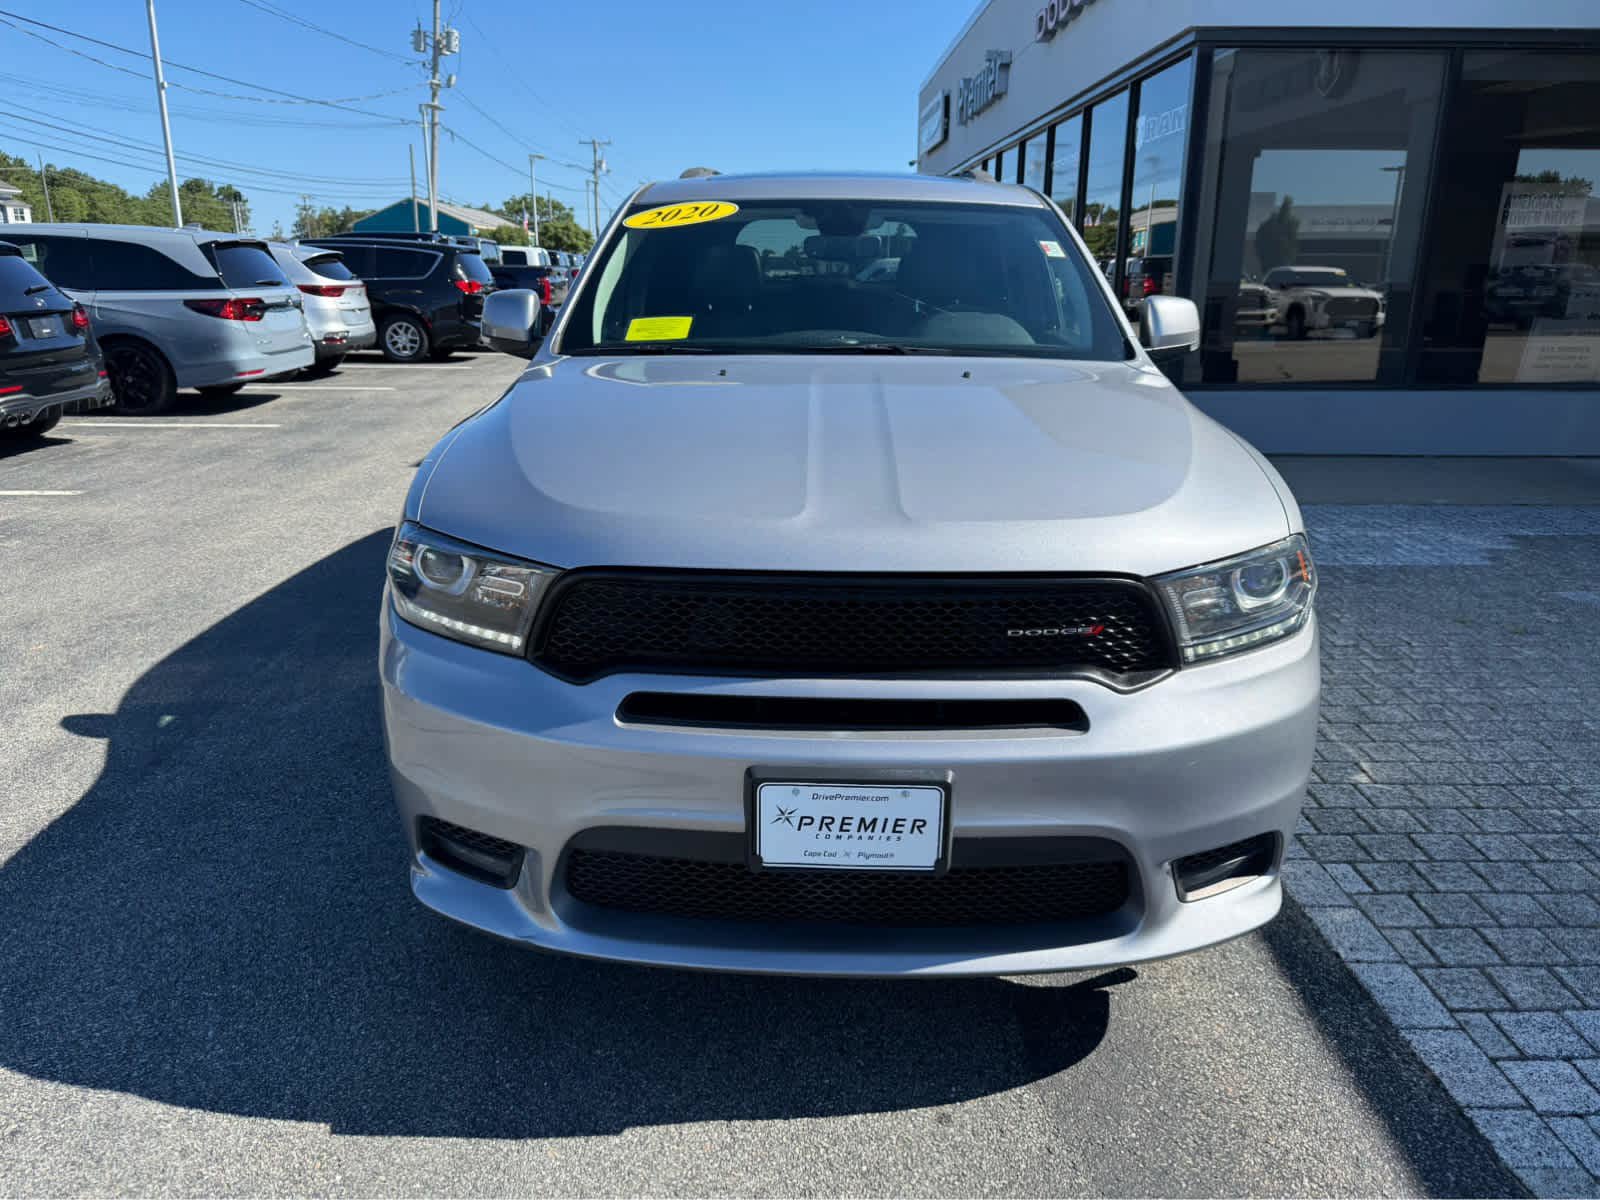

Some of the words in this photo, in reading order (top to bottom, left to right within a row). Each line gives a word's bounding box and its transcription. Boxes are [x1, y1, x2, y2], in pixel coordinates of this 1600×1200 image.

[1034, 0, 1083, 42] DOD
[958, 51, 1011, 126] Premier
[641, 203, 719, 225] 2020
[1007, 627, 1092, 637] DODGE
[811, 792, 889, 803] DrivePremier.com
[797, 815, 927, 835] PREMIER
[815, 833, 902, 842] COMPANIES
[803, 849, 822, 859] Cape
[823, 850, 837, 858] Cod
